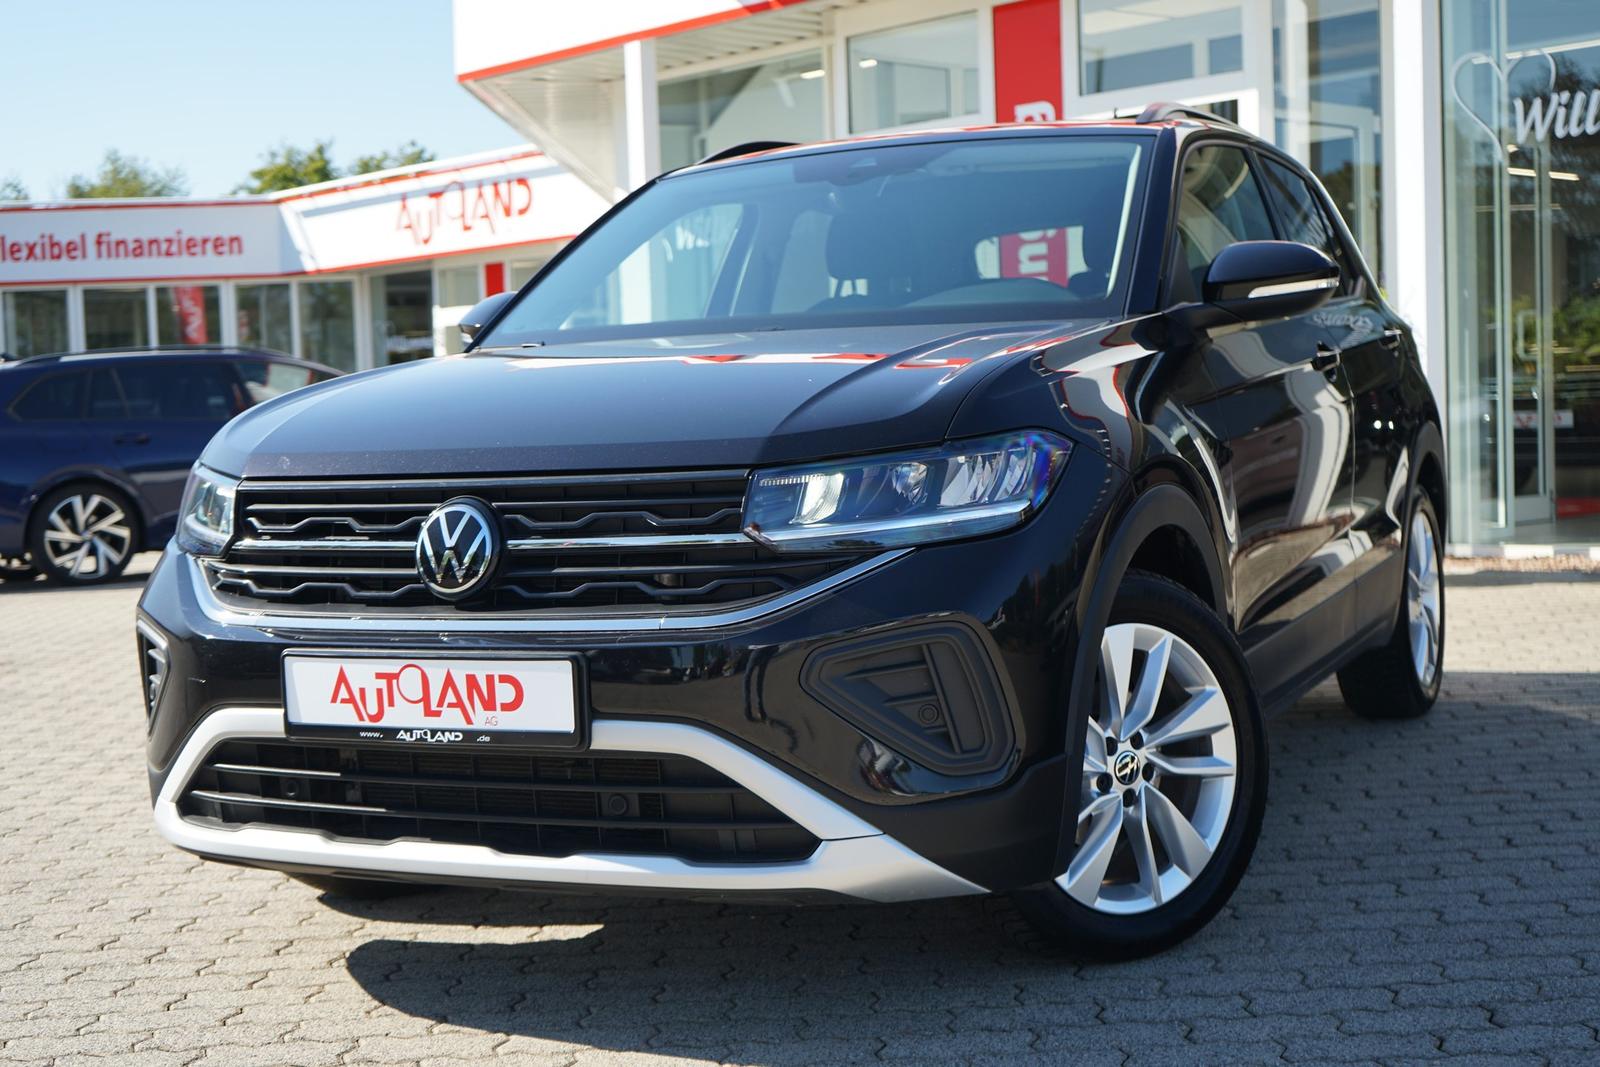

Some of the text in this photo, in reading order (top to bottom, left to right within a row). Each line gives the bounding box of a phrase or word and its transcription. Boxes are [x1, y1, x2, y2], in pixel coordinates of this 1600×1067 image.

[95, 229, 244, 260] finanzieren
[330, 663, 525, 725] AUTOLAND
[484, 716, 498, 727] AG
[359, 729, 491, 743] www. AUTOLAND .de
